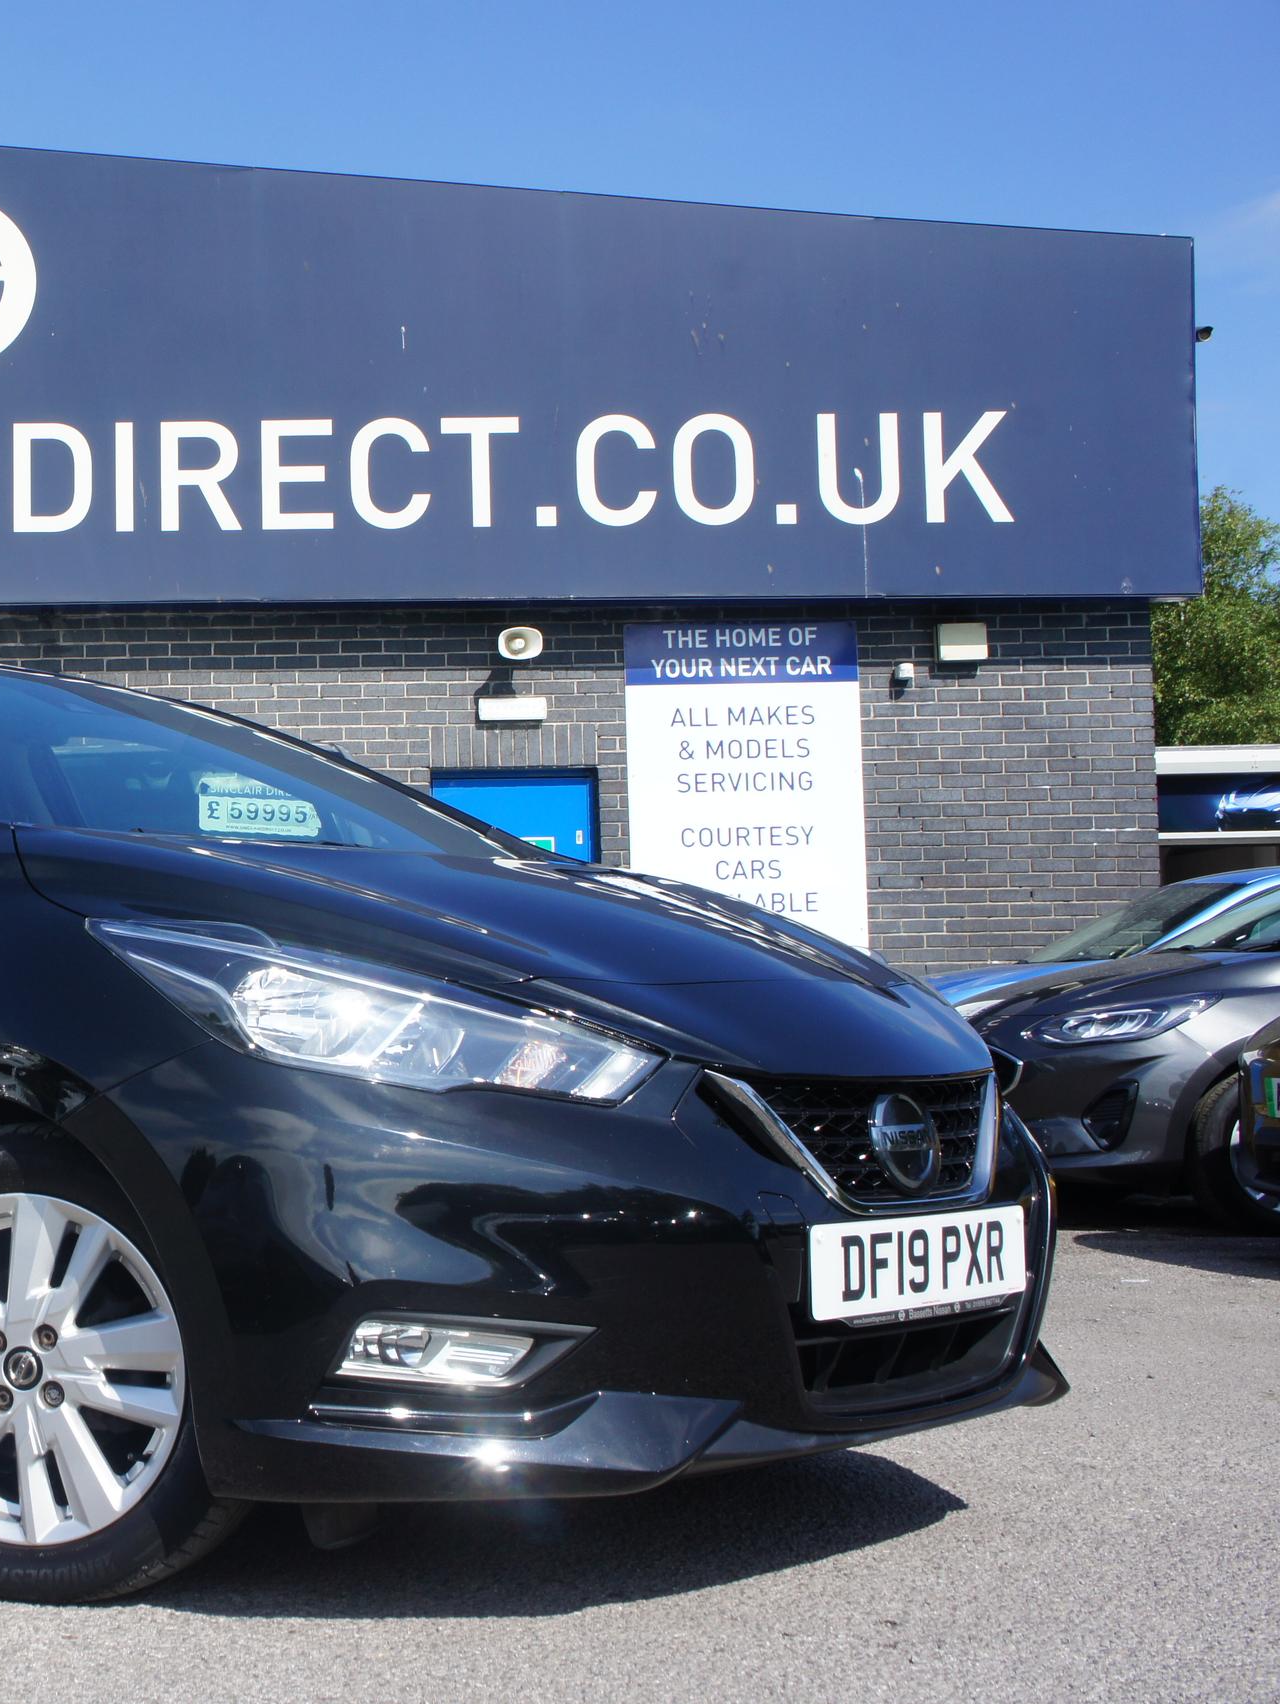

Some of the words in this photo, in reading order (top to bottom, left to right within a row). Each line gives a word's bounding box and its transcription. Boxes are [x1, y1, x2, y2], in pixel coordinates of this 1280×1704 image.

[663, 629, 708, 649] THE
[715, 628, 782, 647] HOME
[788, 627, 817, 646] OF
[651, 658, 713, 678] YOUR
[719, 656, 779, 677] NEXT
[786, 655, 832, 675] CAR
[670, 707, 718, 727] ALL
[727, 705, 815, 726] MAKES
[678, 740, 695, 760] &
[706, 738, 811, 760] MODELS
[211, 785, 262, 796] SINCLAIR
[677, 771, 813, 793] SERVICING
[208, 801, 220, 819] £
[230, 802, 308, 823] 59995
[681, 826, 814, 847] COURTESY
[715, 859, 782, 880] CARS
[841, 1228, 929, 1302] DF19
[942, 1220, 1004, 1289] PXR
